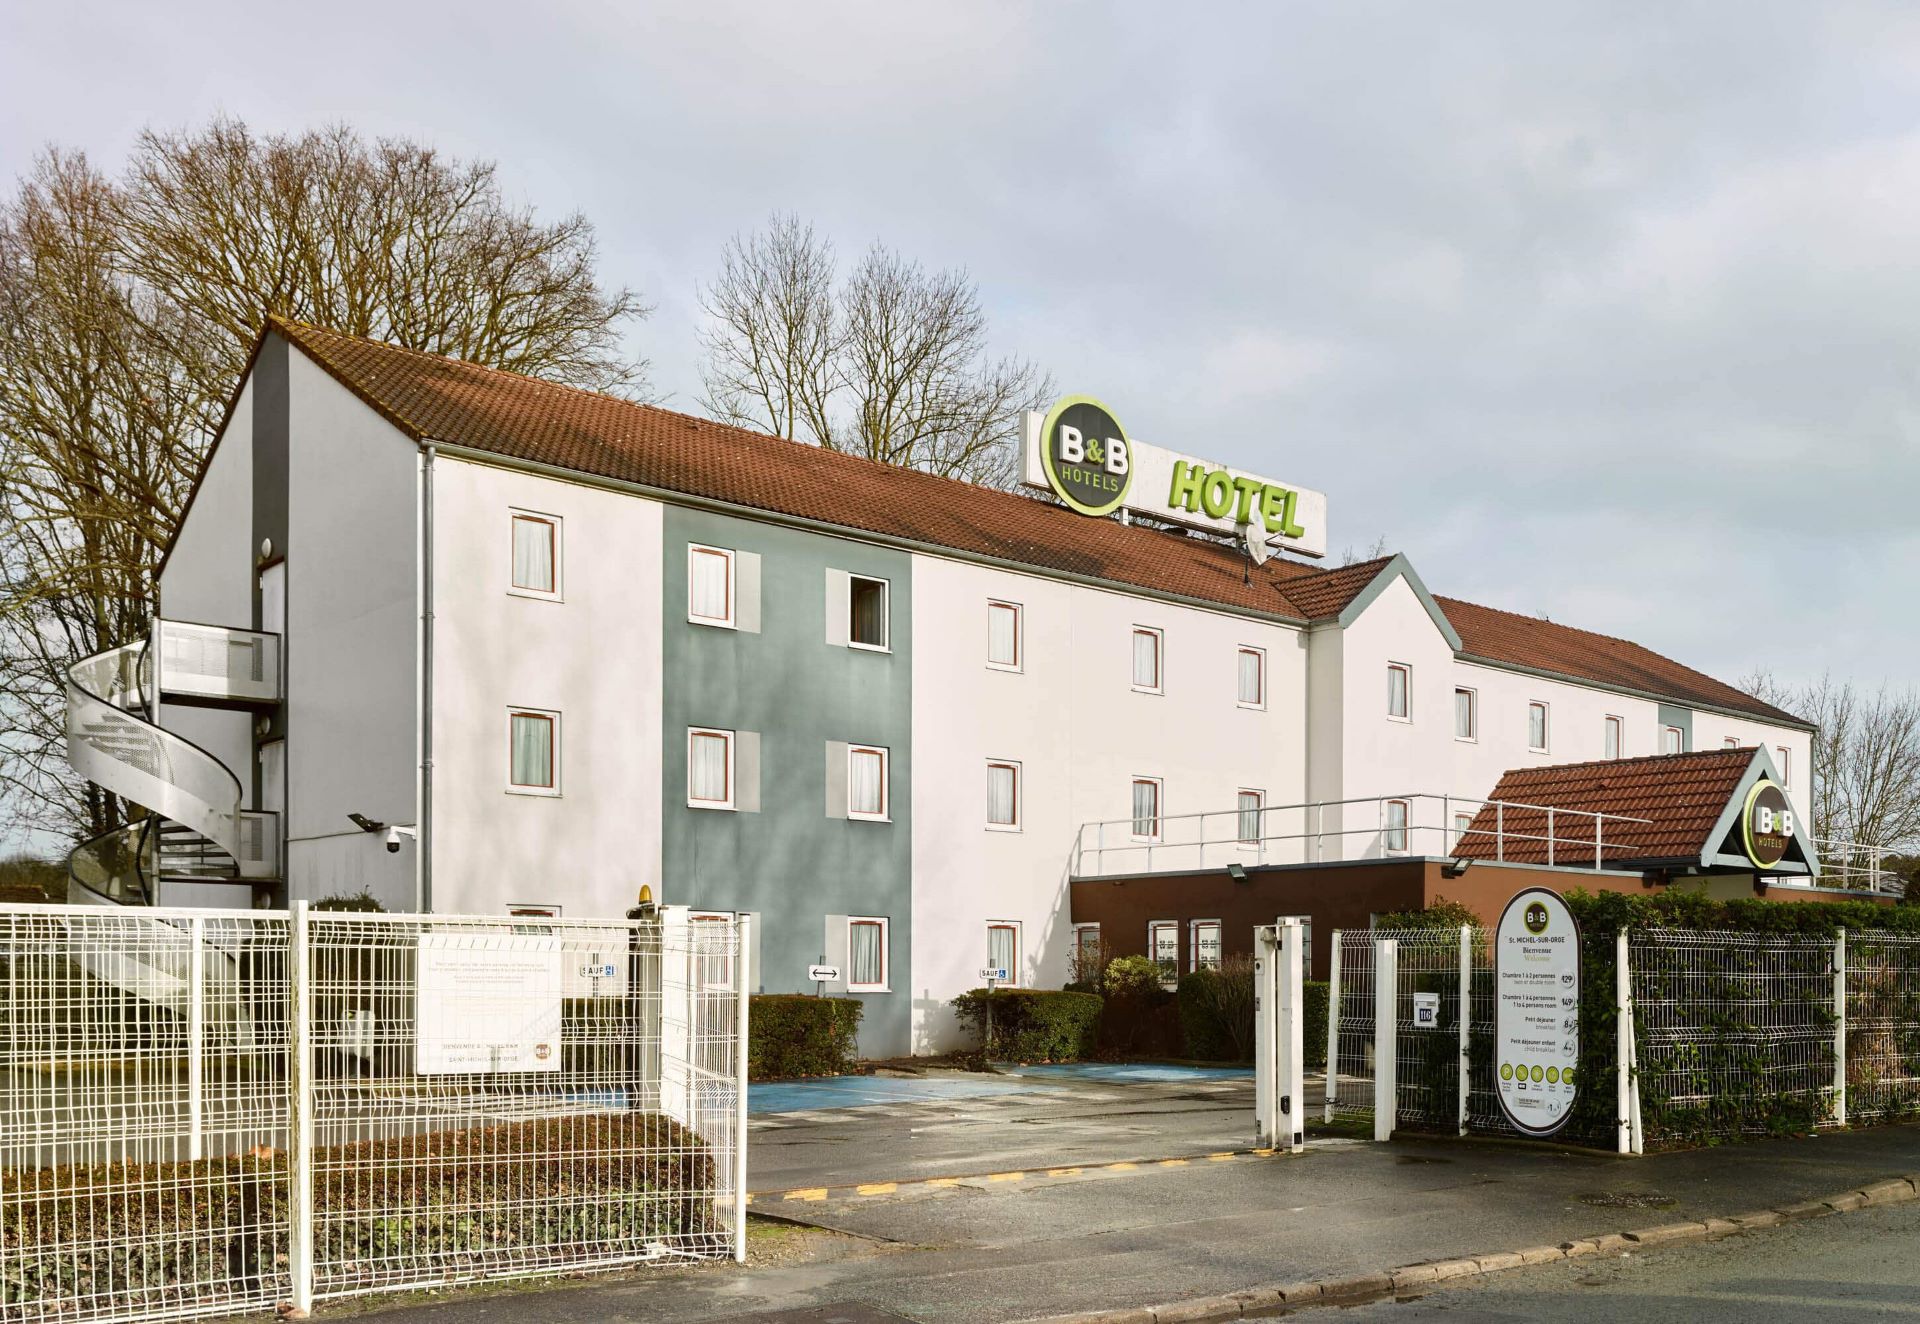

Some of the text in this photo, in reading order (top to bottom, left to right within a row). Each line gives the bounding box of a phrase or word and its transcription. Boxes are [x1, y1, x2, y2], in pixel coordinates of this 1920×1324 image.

[1059, 424, 1129, 475] B&B
[1062, 465, 1119, 492] HOTELS
[1168, 460, 1304, 539] HOTEL
[1756, 806, 1794, 837] B&B
[1758, 838, 1783, 849] HOTELS
[1527, 911, 1547, 923] B&B
[1420, 1010, 1431, 1020] 116
